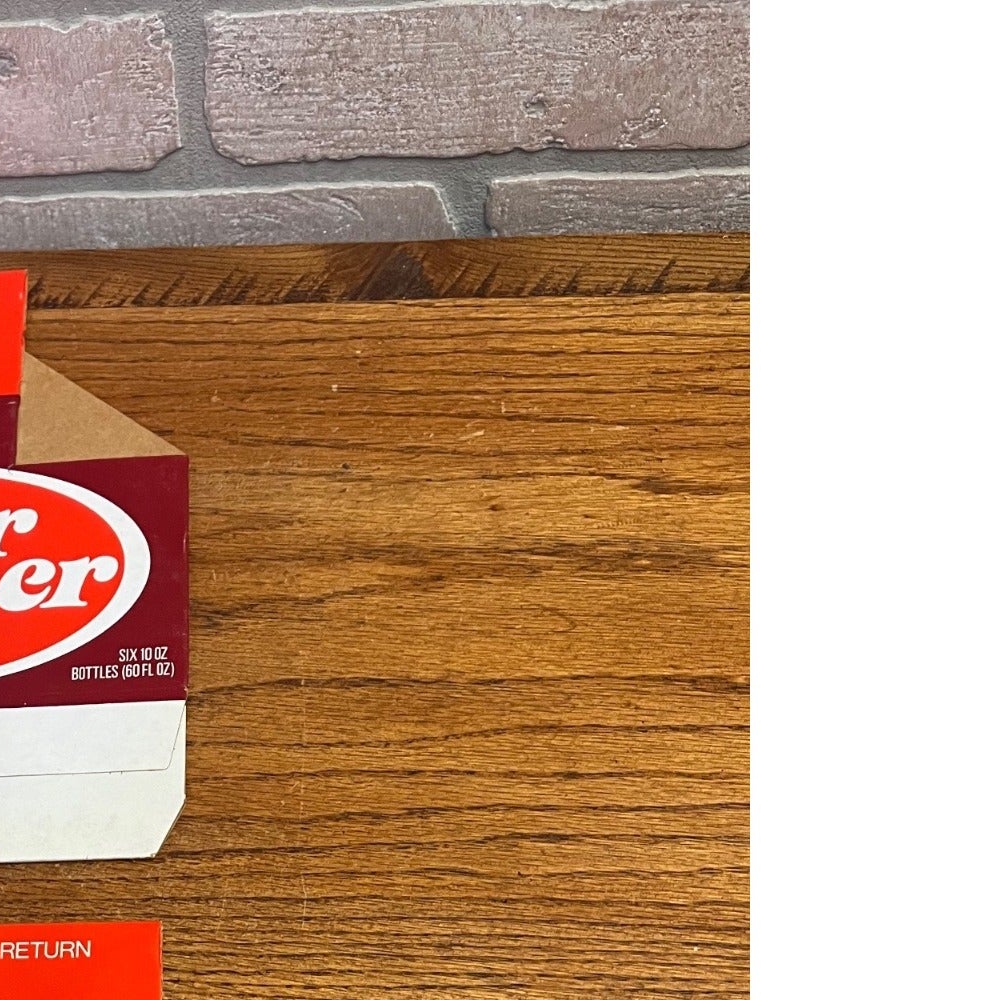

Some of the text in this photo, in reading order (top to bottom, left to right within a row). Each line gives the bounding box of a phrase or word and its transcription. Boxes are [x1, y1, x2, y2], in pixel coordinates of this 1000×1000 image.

[119, 646, 168, 662] SIX 10 OZ
[71, 665, 118, 680] BOTTLES
[156, 662, 175, 677] OZ)
[0, 940, 92, 960] RETURN
